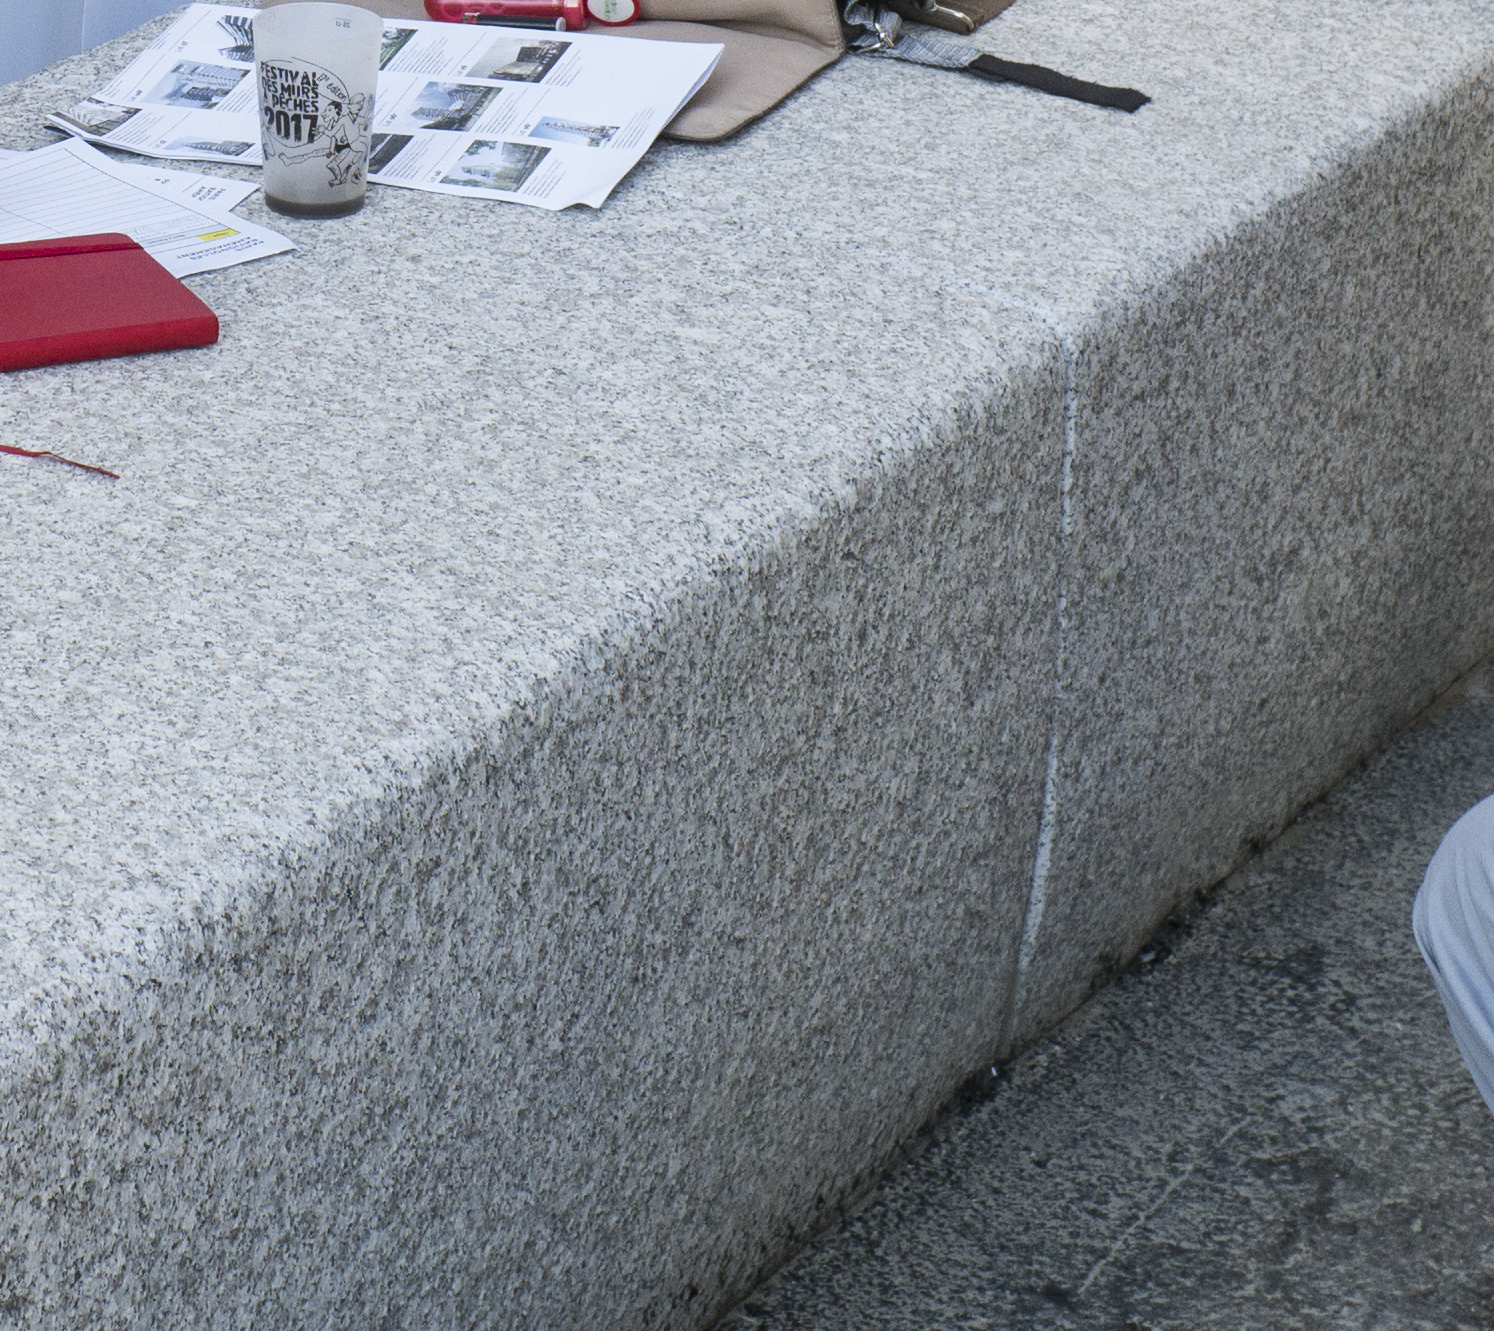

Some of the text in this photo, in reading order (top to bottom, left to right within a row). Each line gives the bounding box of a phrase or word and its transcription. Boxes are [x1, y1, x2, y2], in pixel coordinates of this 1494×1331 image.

[261, 61, 318, 87] FESTIVAL
[262, 76, 318, 99] DES MURS
[264, 106, 318, 143] 2017
